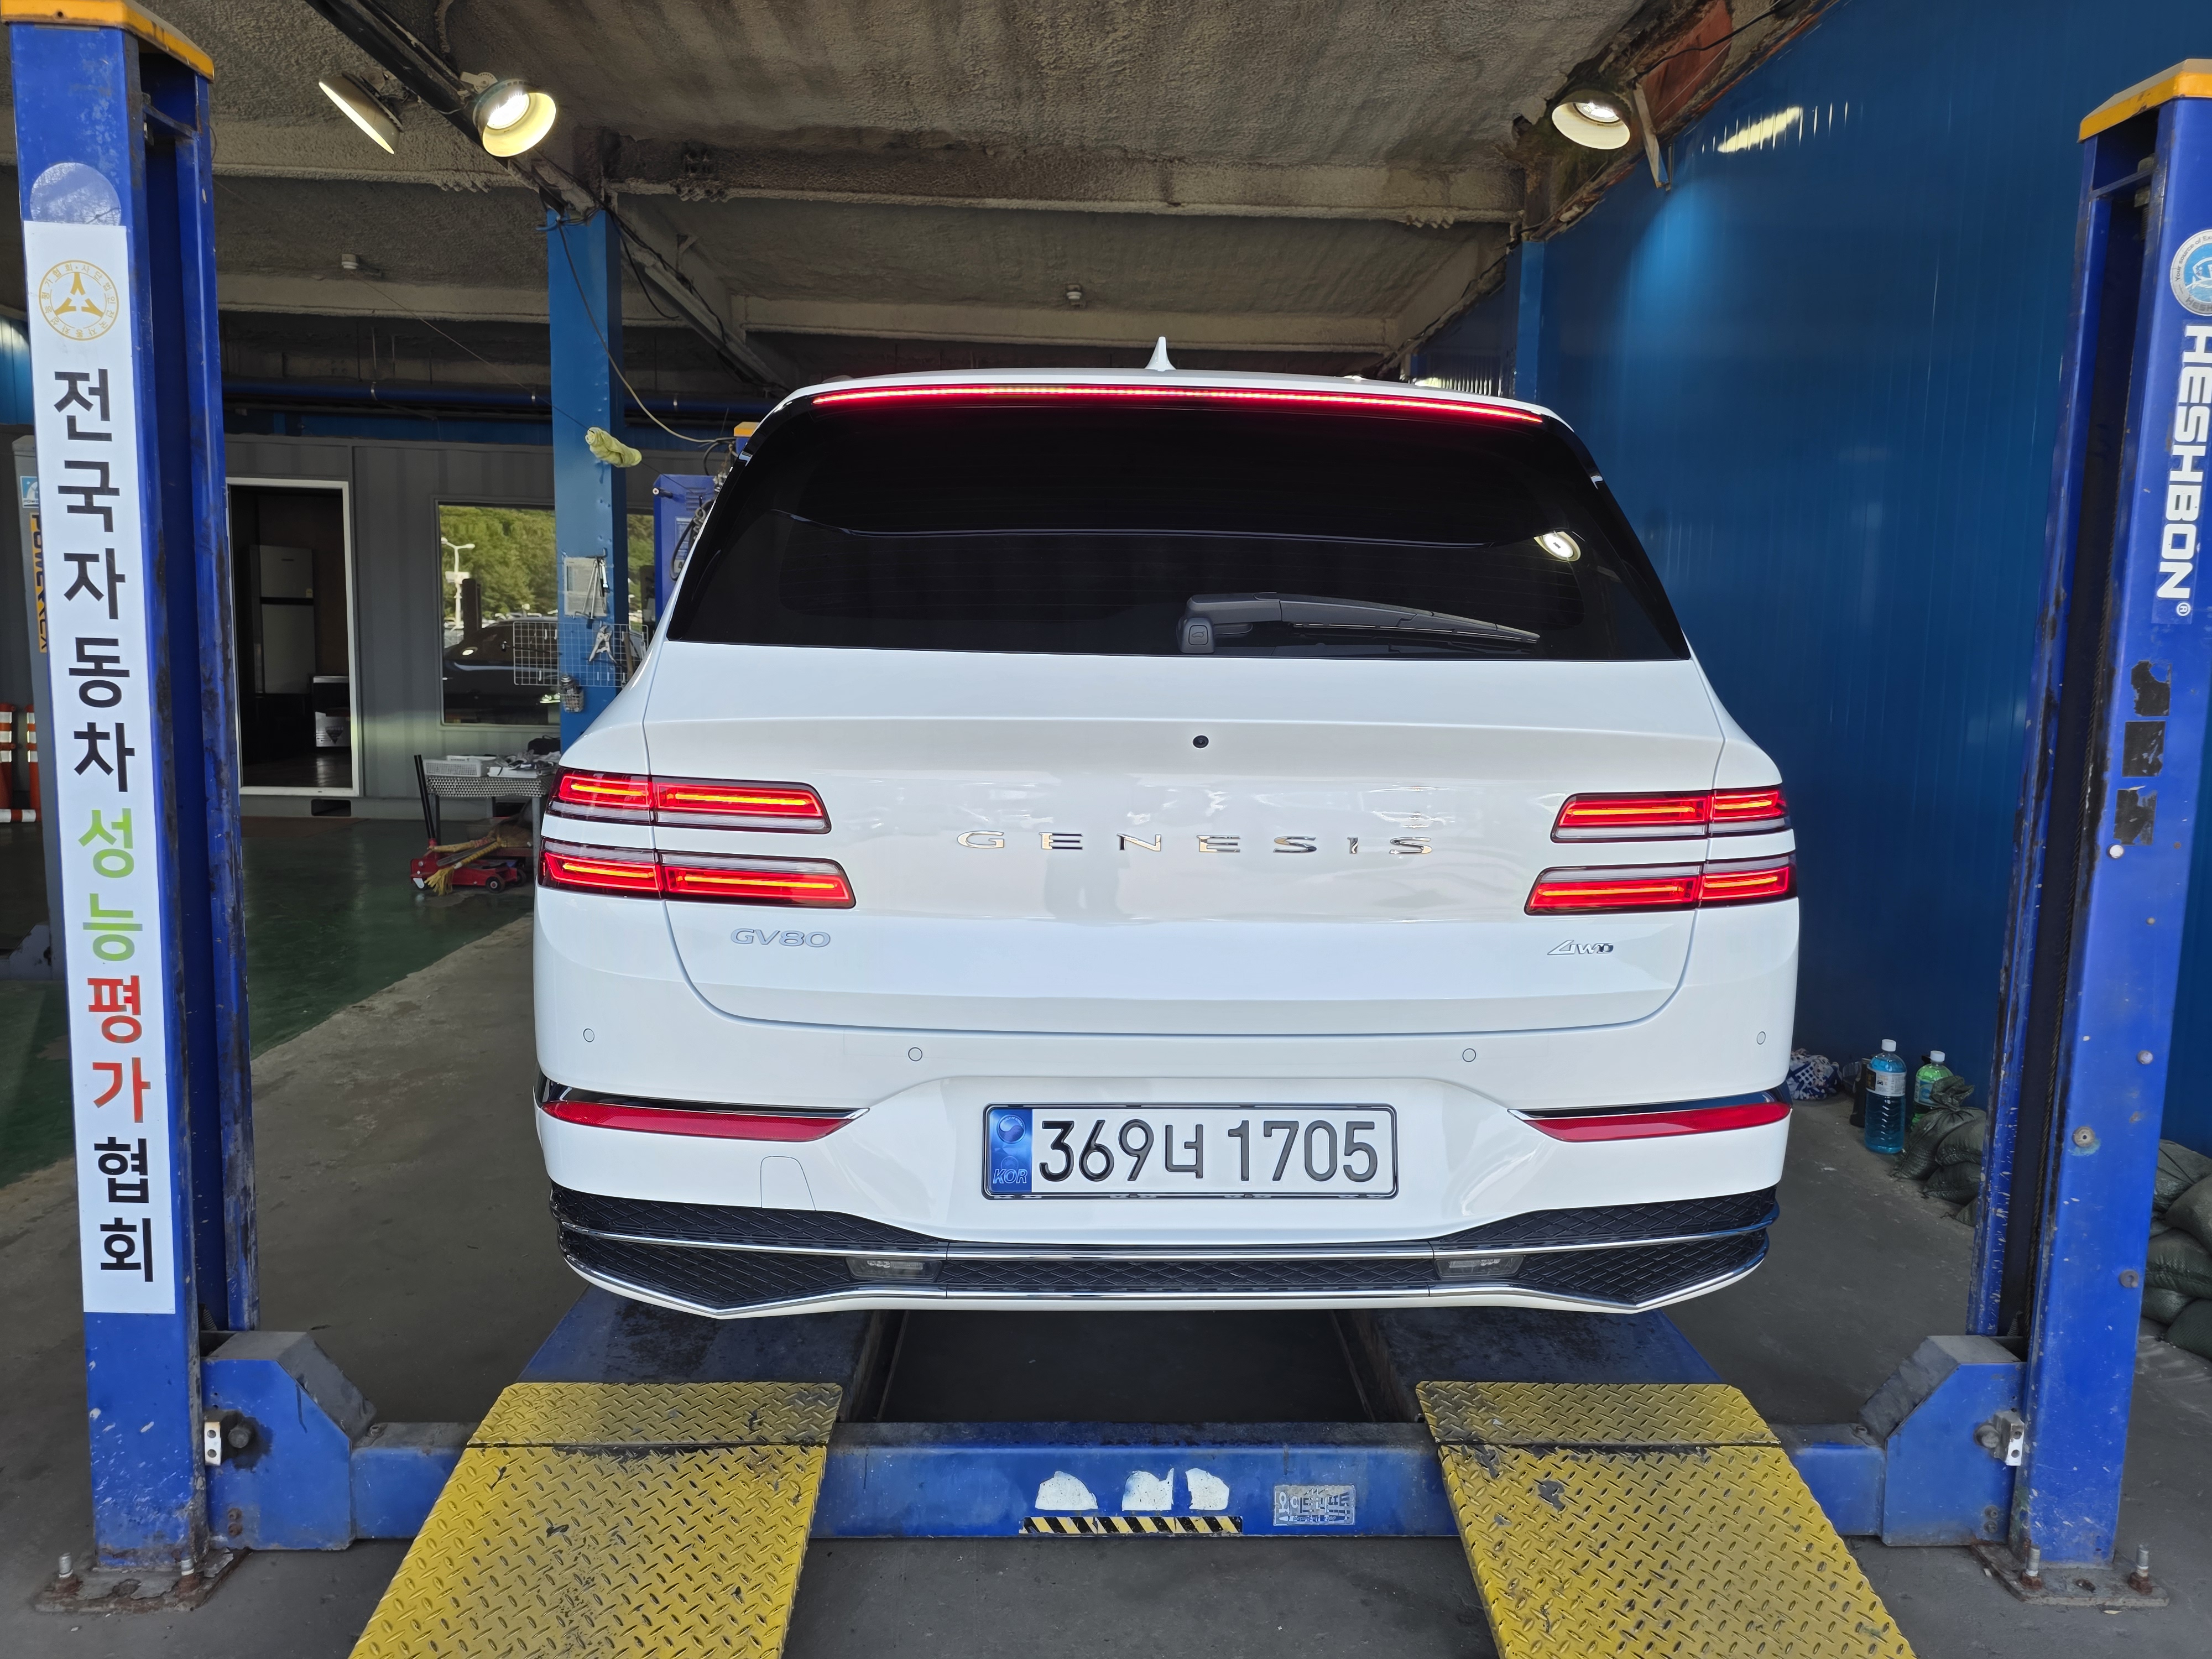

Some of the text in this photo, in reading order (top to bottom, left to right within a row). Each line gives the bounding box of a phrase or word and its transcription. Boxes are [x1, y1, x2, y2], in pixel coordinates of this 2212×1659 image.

[2179, 243, 2195, 263] source
[2157, 325, 2212, 599] HESHBON
[957, 830, 1433, 854] GENESIS
[731, 928, 831, 948] GV80
[1547, 940, 1614, 956] 4WD
[1039, 1119, 1379, 1183] 369너 1705
[993, 1168, 1028, 1184] KOR
